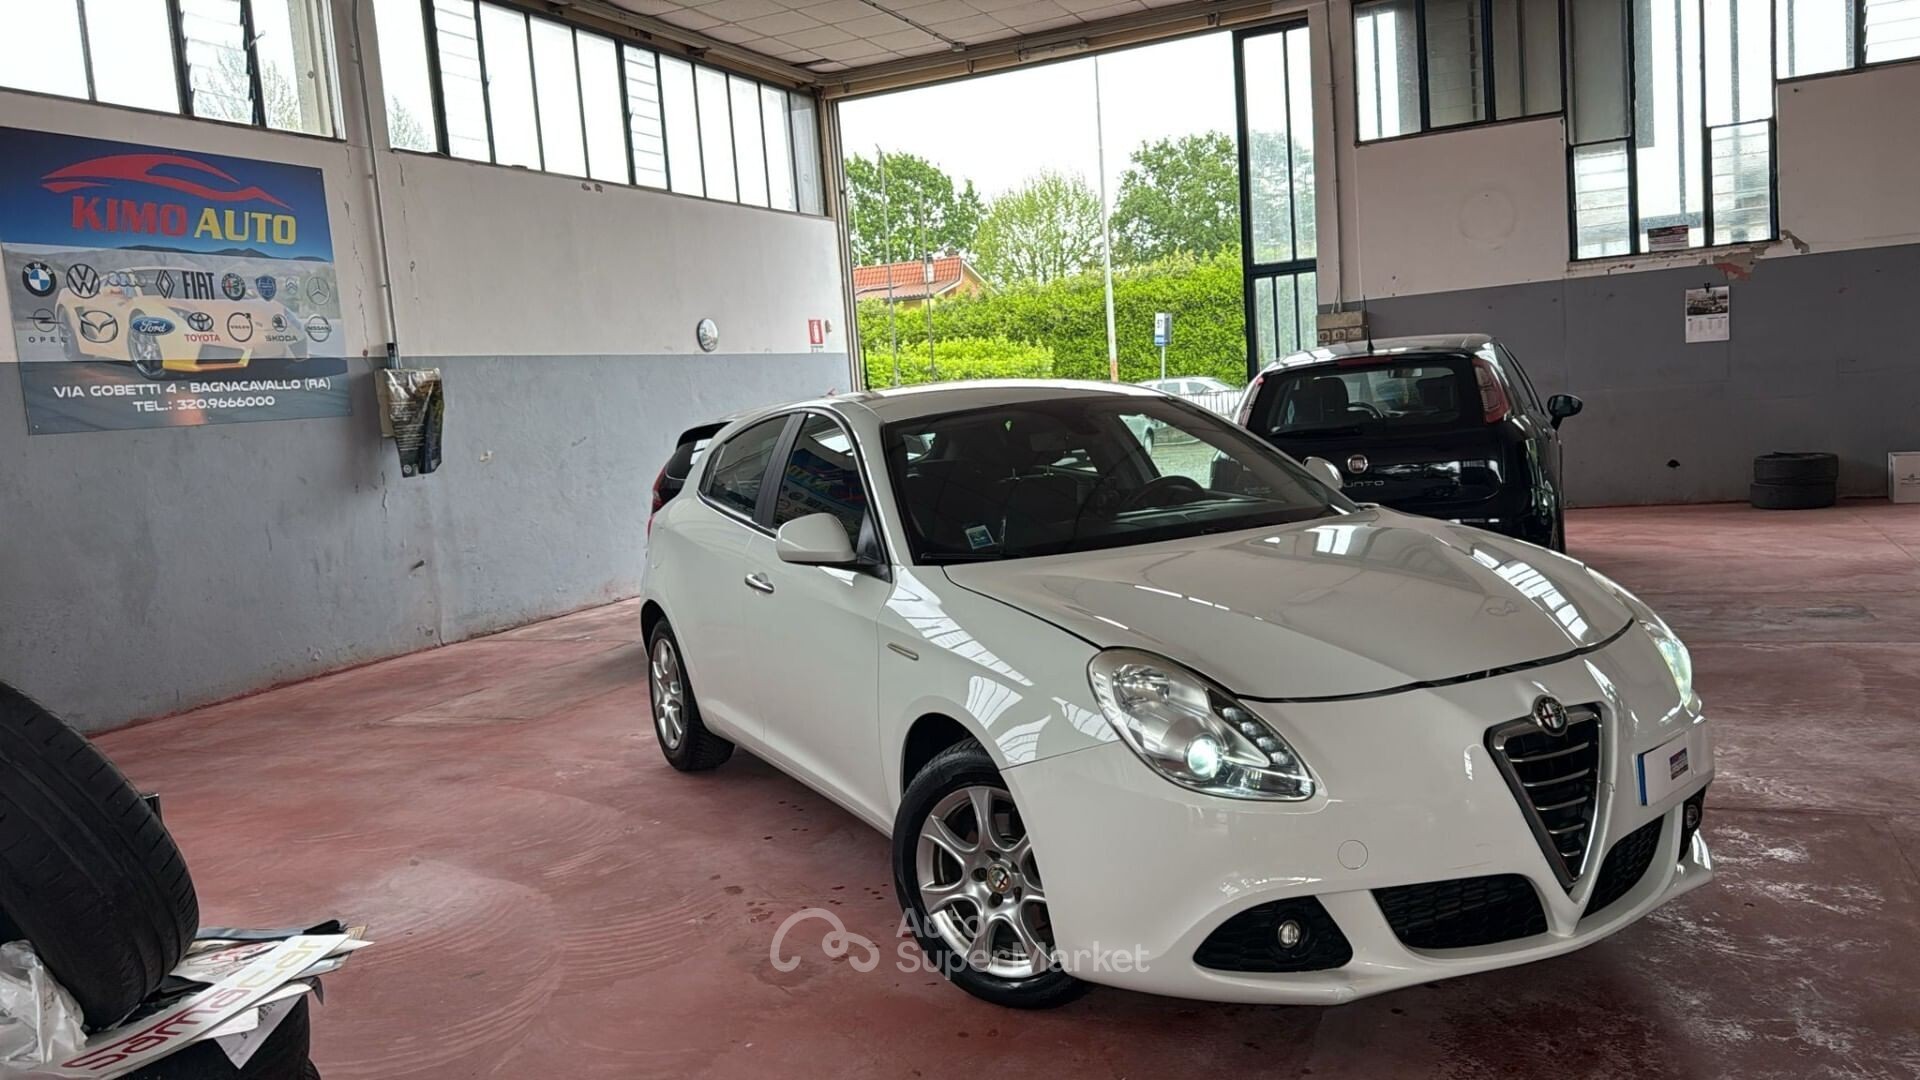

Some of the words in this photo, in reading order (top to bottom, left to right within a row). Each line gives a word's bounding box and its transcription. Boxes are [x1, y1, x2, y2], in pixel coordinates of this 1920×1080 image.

[71, 195, 189, 238] KIMO
[194, 207, 297, 246] AUTO
[181, 270, 216, 300] FIAT
[139, 319, 168, 334] Ford
[28, 336, 69, 344] OPEL
[184, 333, 221, 343] TOYOTA
[53, 385, 85, 399] VIA
[90, 384, 162, 398] GOBETTI
[166, 383, 177, 395] 4
[190, 379, 301, 395] BAGNACAVALLO
[304, 376, 332, 392] (RA)
[133, 400, 173, 413] TEL.:
[177, 395, 276, 411] 320.9666000
[1343, 480, 1385, 488] UNTO
